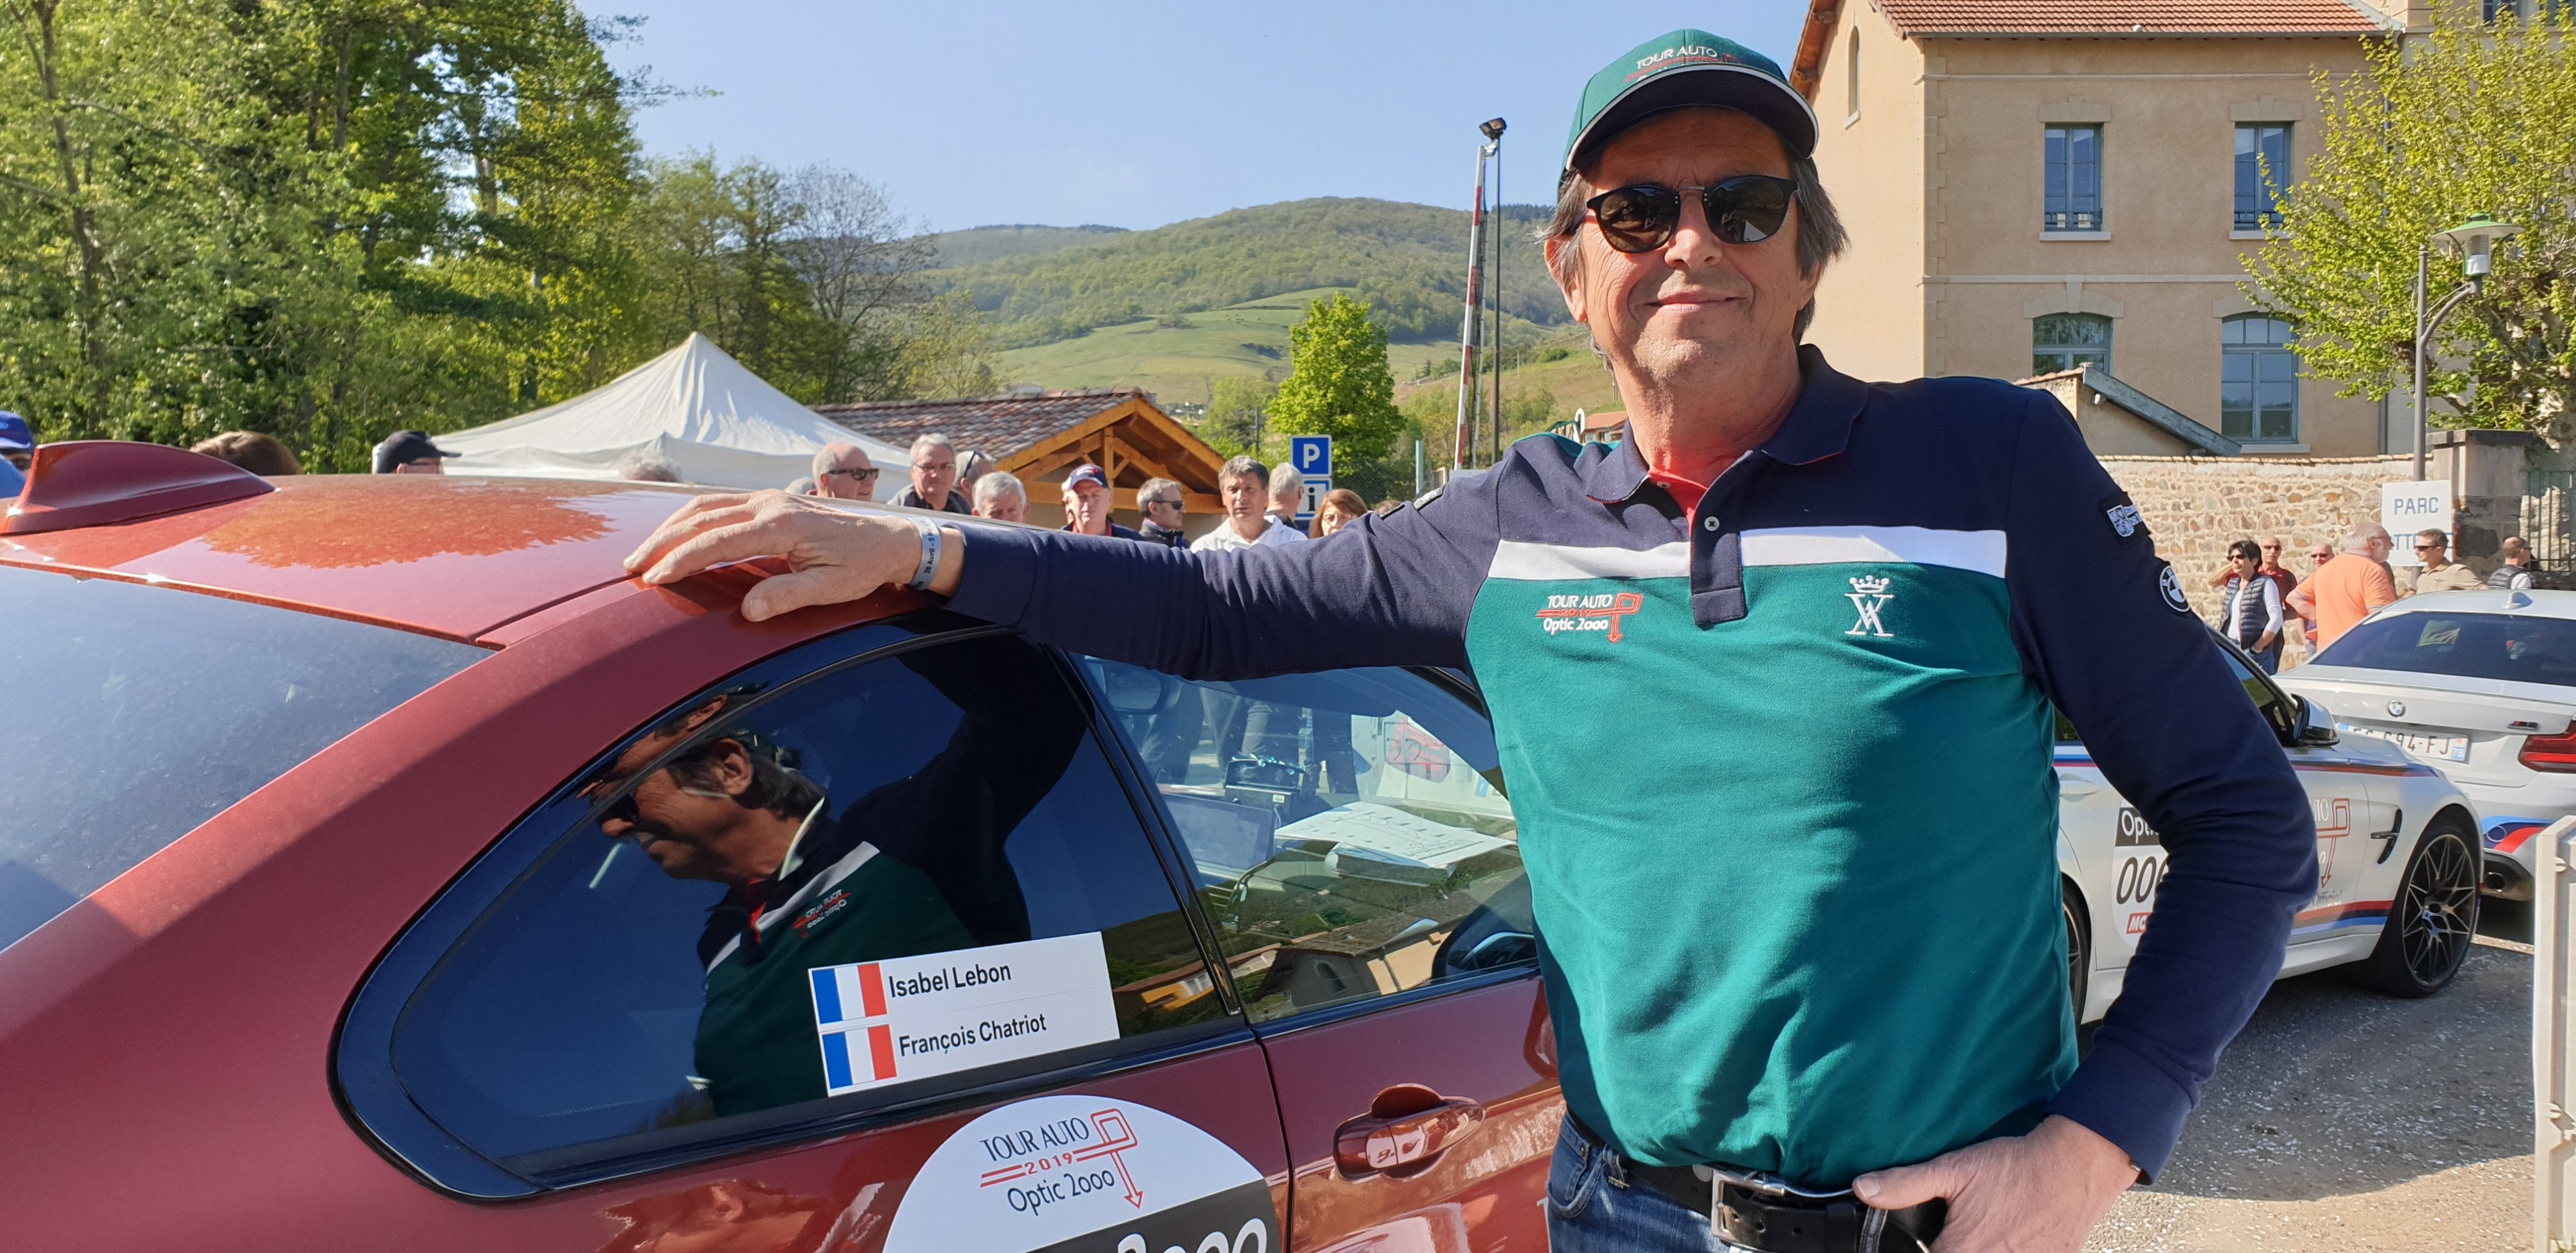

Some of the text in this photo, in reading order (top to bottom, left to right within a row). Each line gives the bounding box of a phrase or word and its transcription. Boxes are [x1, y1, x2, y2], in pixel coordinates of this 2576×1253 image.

[1636, 45, 1718, 70] TOUR AUTO
[1303, 443, 1320, 469] P
[2394, 497, 2439, 515] PARC
[1547, 594, 1613, 609] TOUR AUTO
[1560, 609, 1593, 617] 2019
[1543, 618, 1574, 636] Optic
[889, 963, 1012, 998] Isabel Lebon
[899, 1013, 1047, 1057] François Chatriot
[979, 1117, 1090, 1162] TOUR AUTO
[1024, 1152, 1073, 1175] 2019
[1007, 1179, 1066, 1217] Optic
